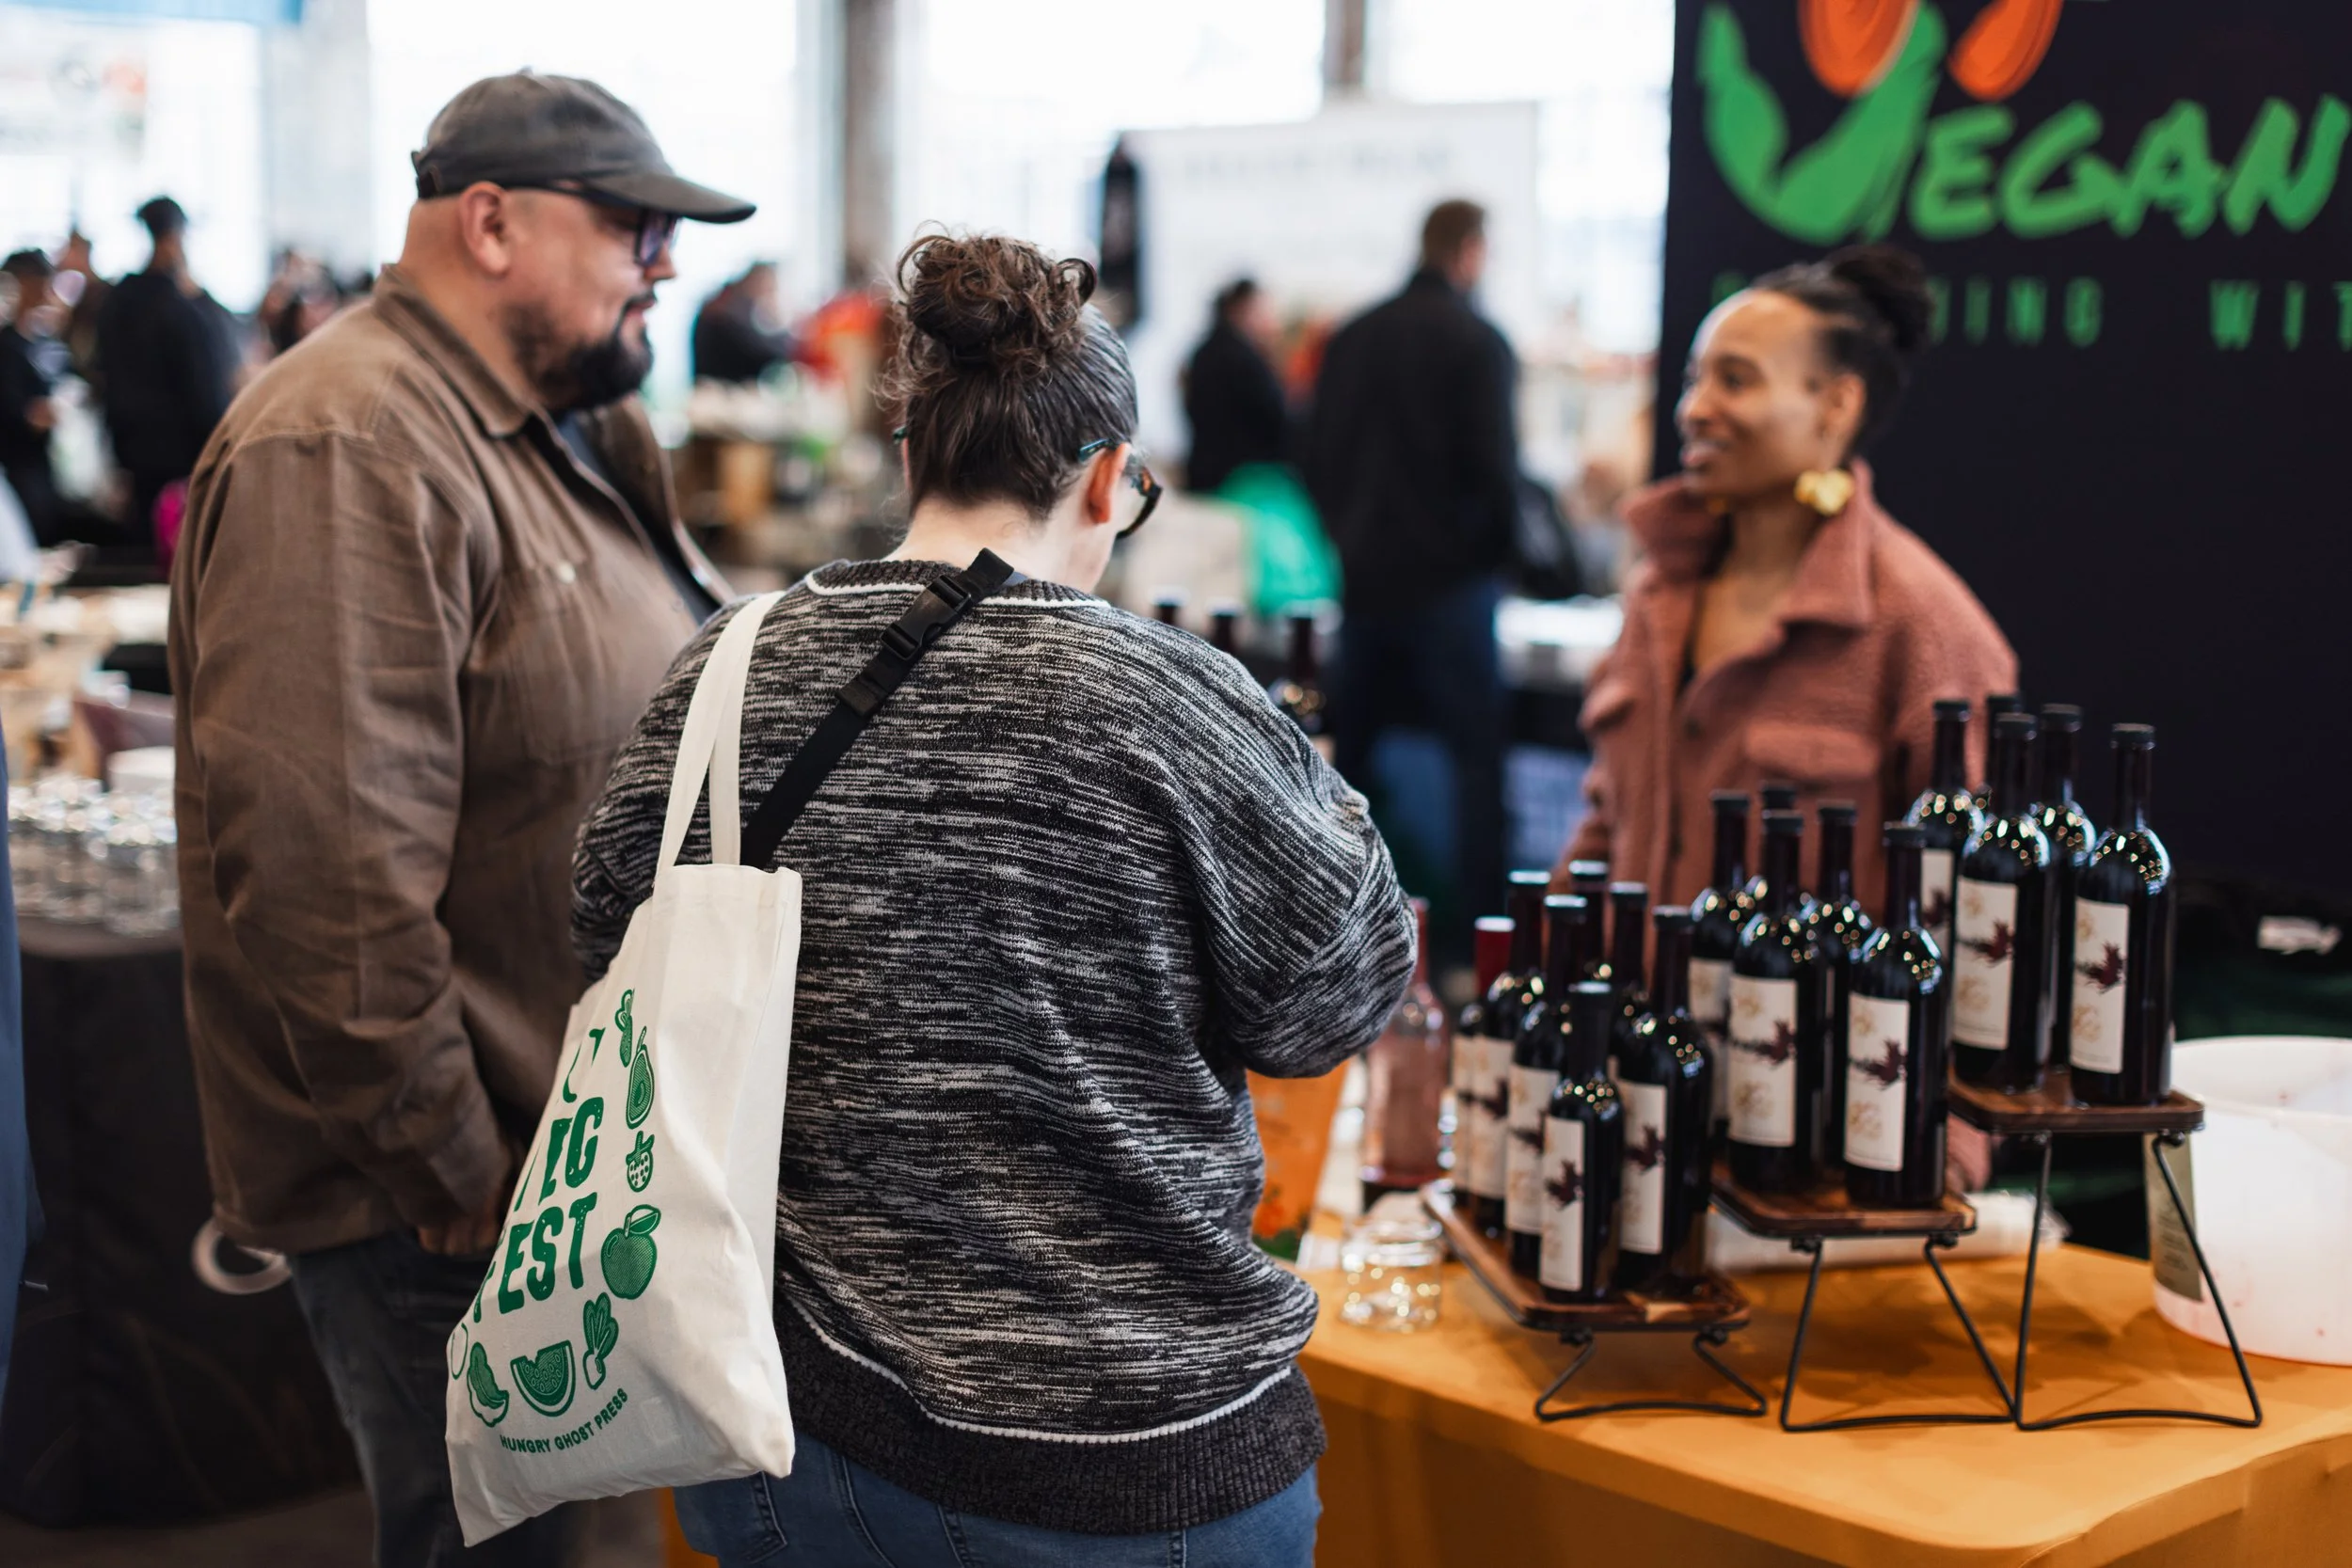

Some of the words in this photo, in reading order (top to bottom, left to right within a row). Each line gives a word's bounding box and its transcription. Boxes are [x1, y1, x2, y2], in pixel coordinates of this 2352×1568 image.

[1697, 3, 2350, 243] VEGAN
[514, 1096, 605, 1212] EG
[500, 1434, 551, 1453] HUNGRY
[554, 1421, 595, 1449] GHOST
[594, 1387, 628, 1430] PRESS
